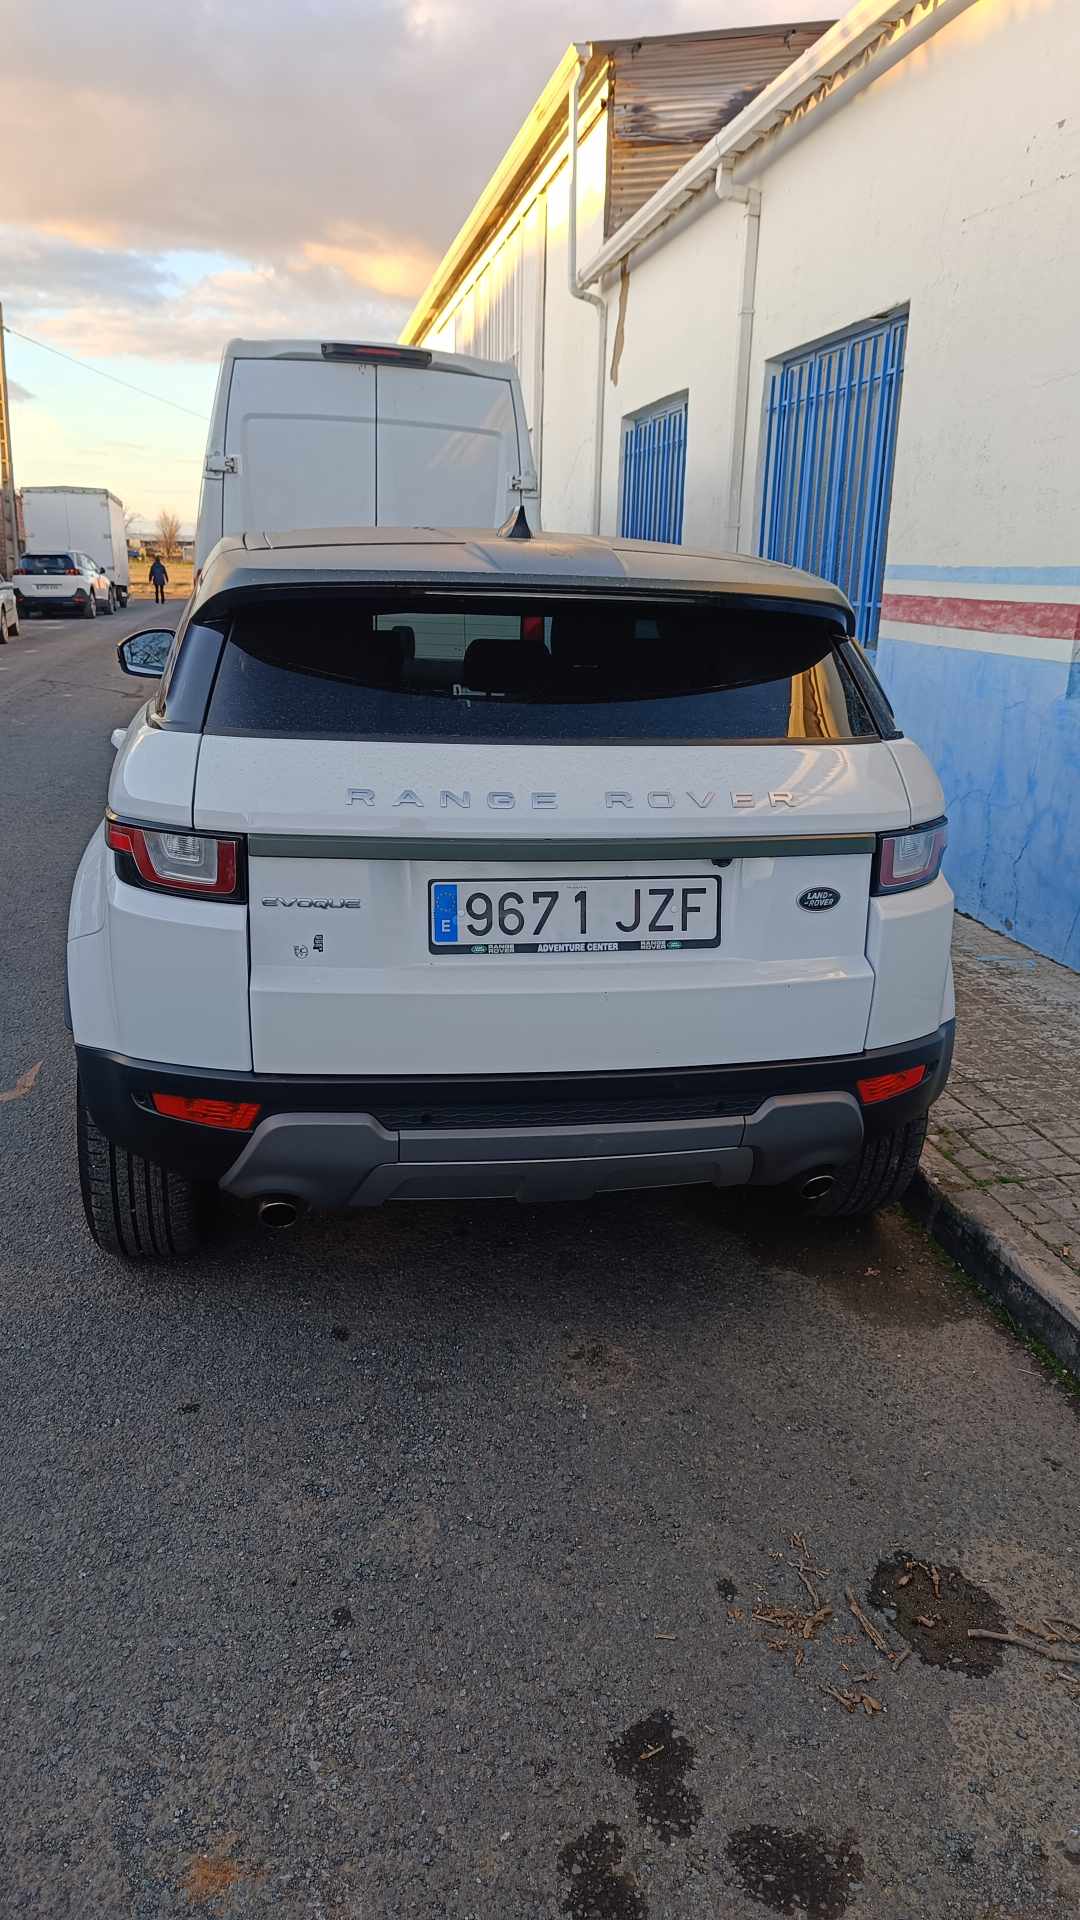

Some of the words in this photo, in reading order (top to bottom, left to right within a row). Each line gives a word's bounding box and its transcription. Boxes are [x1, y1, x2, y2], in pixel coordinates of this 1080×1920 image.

[344, 788, 559, 810] RANGE
[604, 791, 800, 809] ROVER
[261, 896, 361, 910] EVOQUE
[465, 890, 588, 937] 9671
[615, 887, 707, 933] JZF
[441, 919, 451, 933] E
[537, 943, 585, 953] ADVENTURE
[586, 942, 619, 952] CENTER
